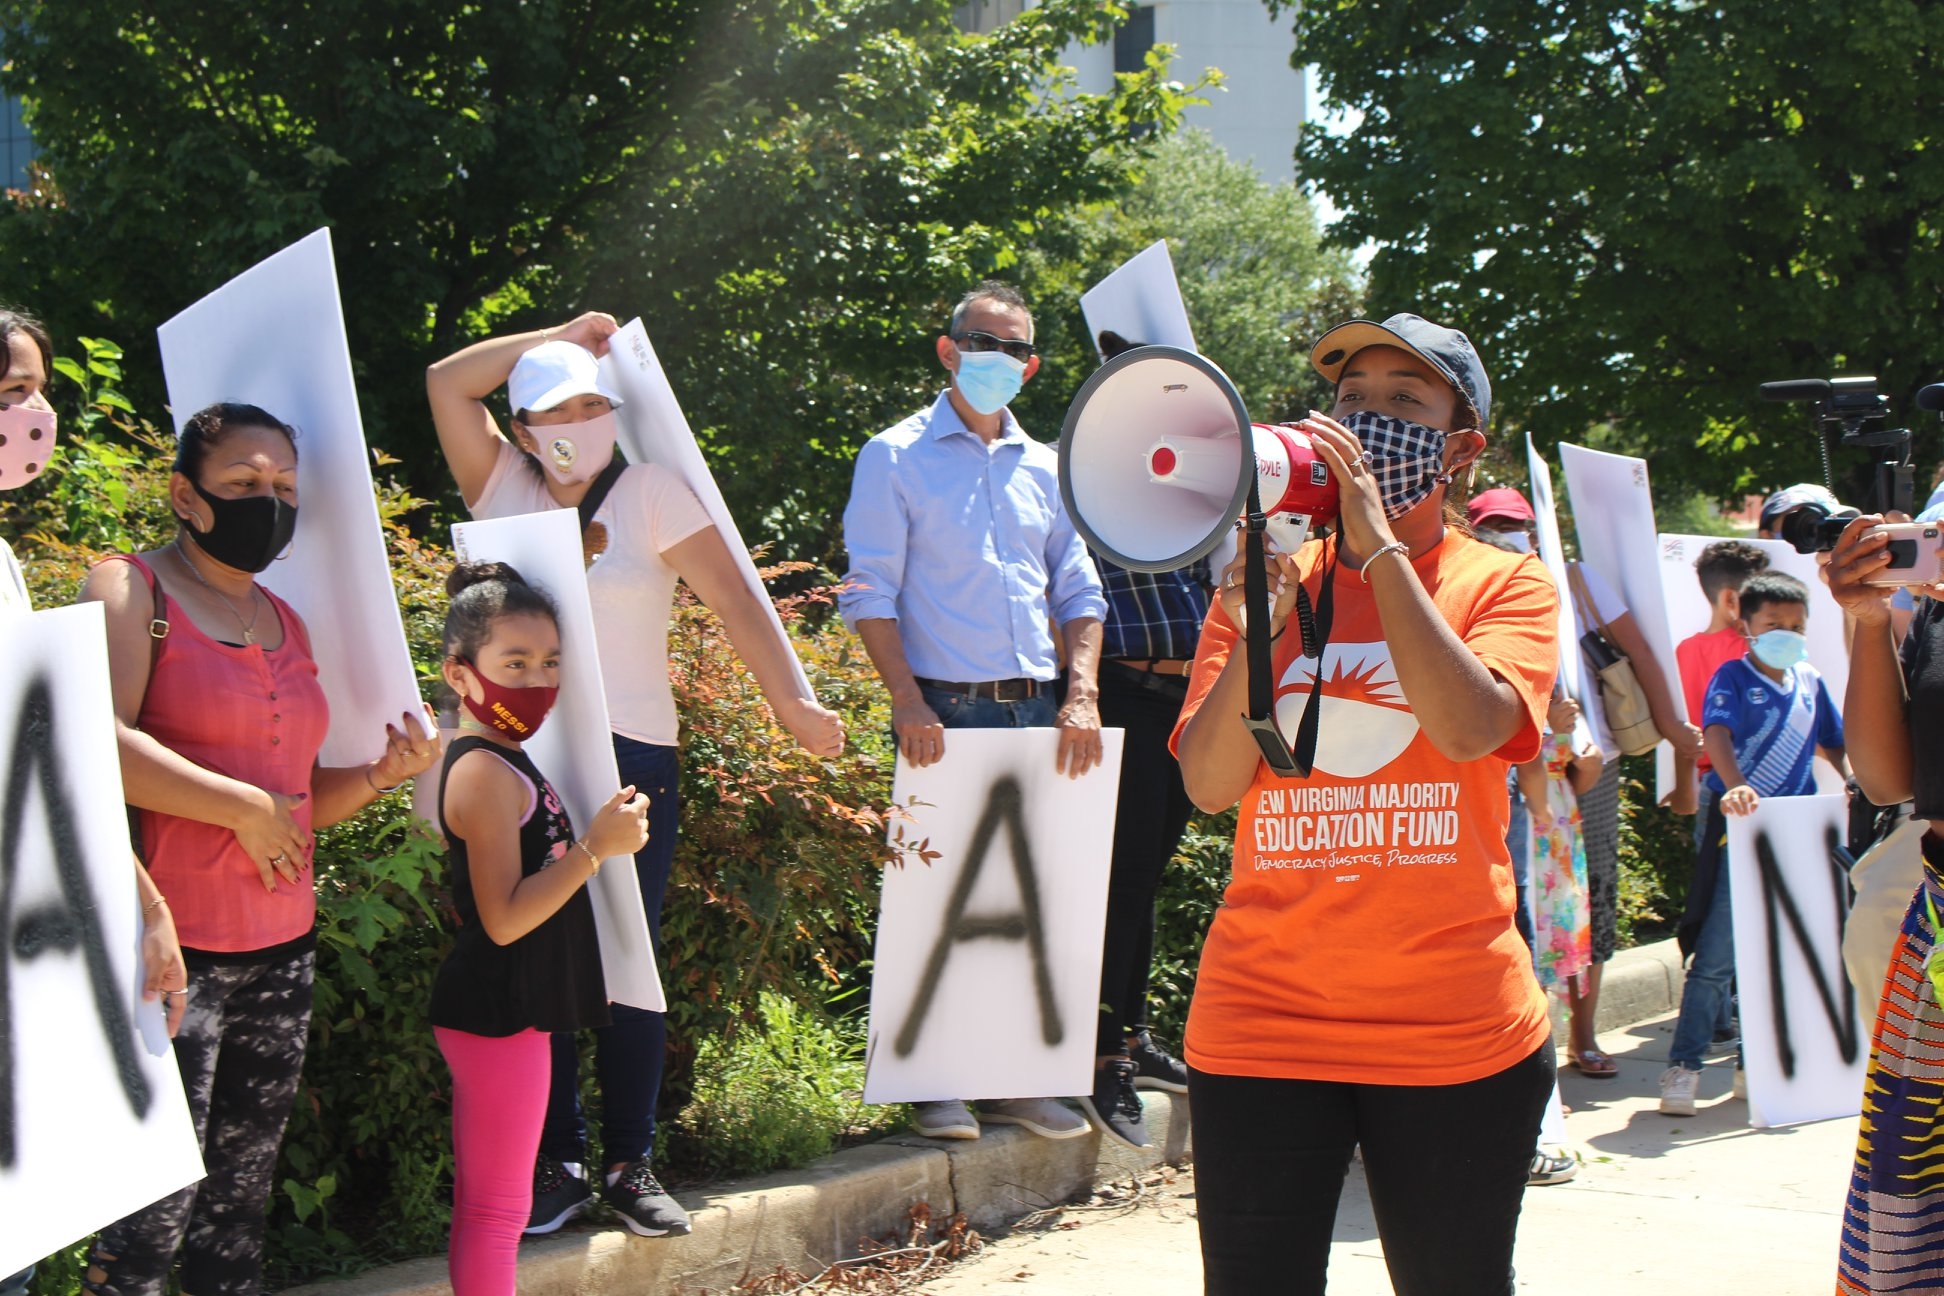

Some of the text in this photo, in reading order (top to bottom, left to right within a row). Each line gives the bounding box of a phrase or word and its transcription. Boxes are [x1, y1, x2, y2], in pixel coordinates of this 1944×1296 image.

[1260, 459, 1281, 477] PYLE
[491, 702, 529, 733] MESSI
[493, 719, 507, 730] 10
[1288, 785, 1365, 813] VIRGINIA
[1369, 782, 1460, 809] MAJORITY
[1254, 810, 1459, 852] EDUCATION FUND
[0, 668, 154, 1172] A
[893, 772, 1066, 1060] A
[1753, 823, 1858, 1081] N
